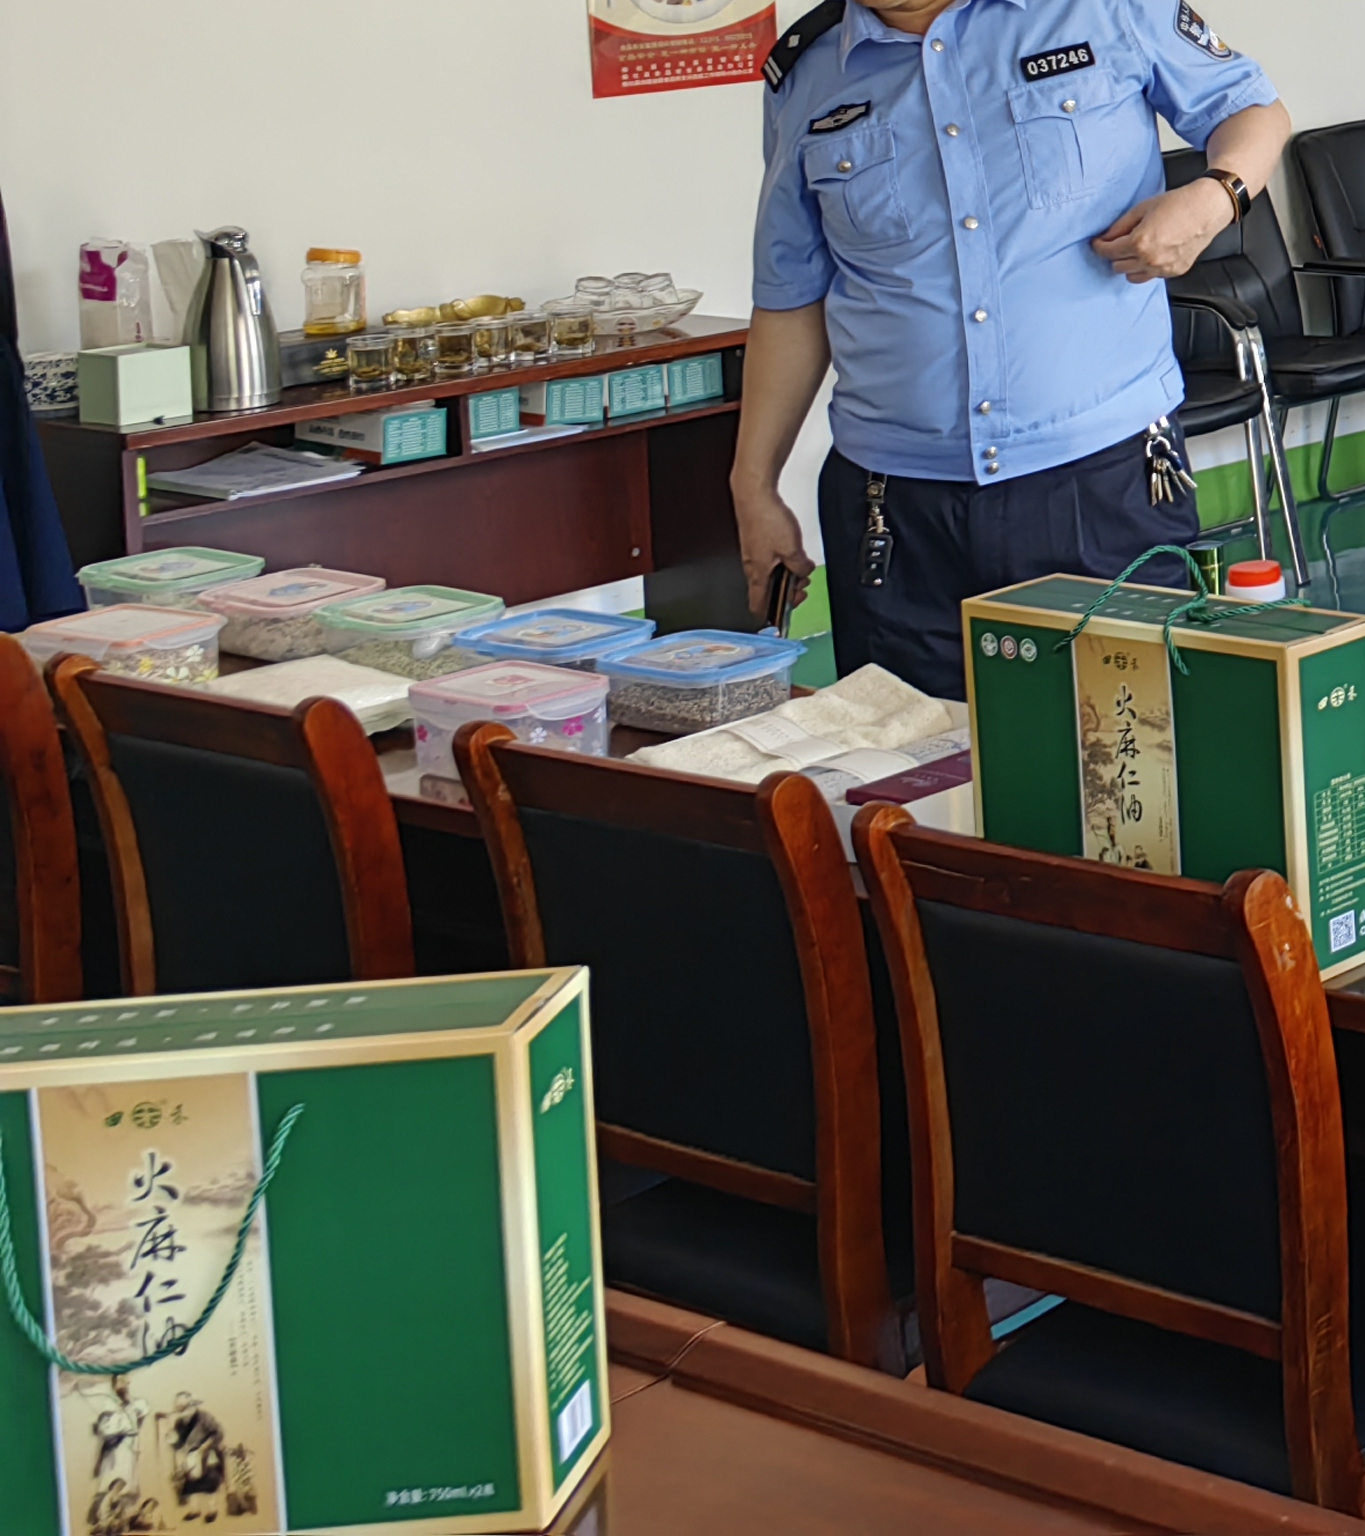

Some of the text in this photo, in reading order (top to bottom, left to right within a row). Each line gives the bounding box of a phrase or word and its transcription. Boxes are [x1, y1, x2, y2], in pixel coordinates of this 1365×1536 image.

[1026, 48, 1089, 76] 037246
[1115, 684, 1143, 825] 火麻仁油
[130, 1151, 188, 1357] 火麻仁油
